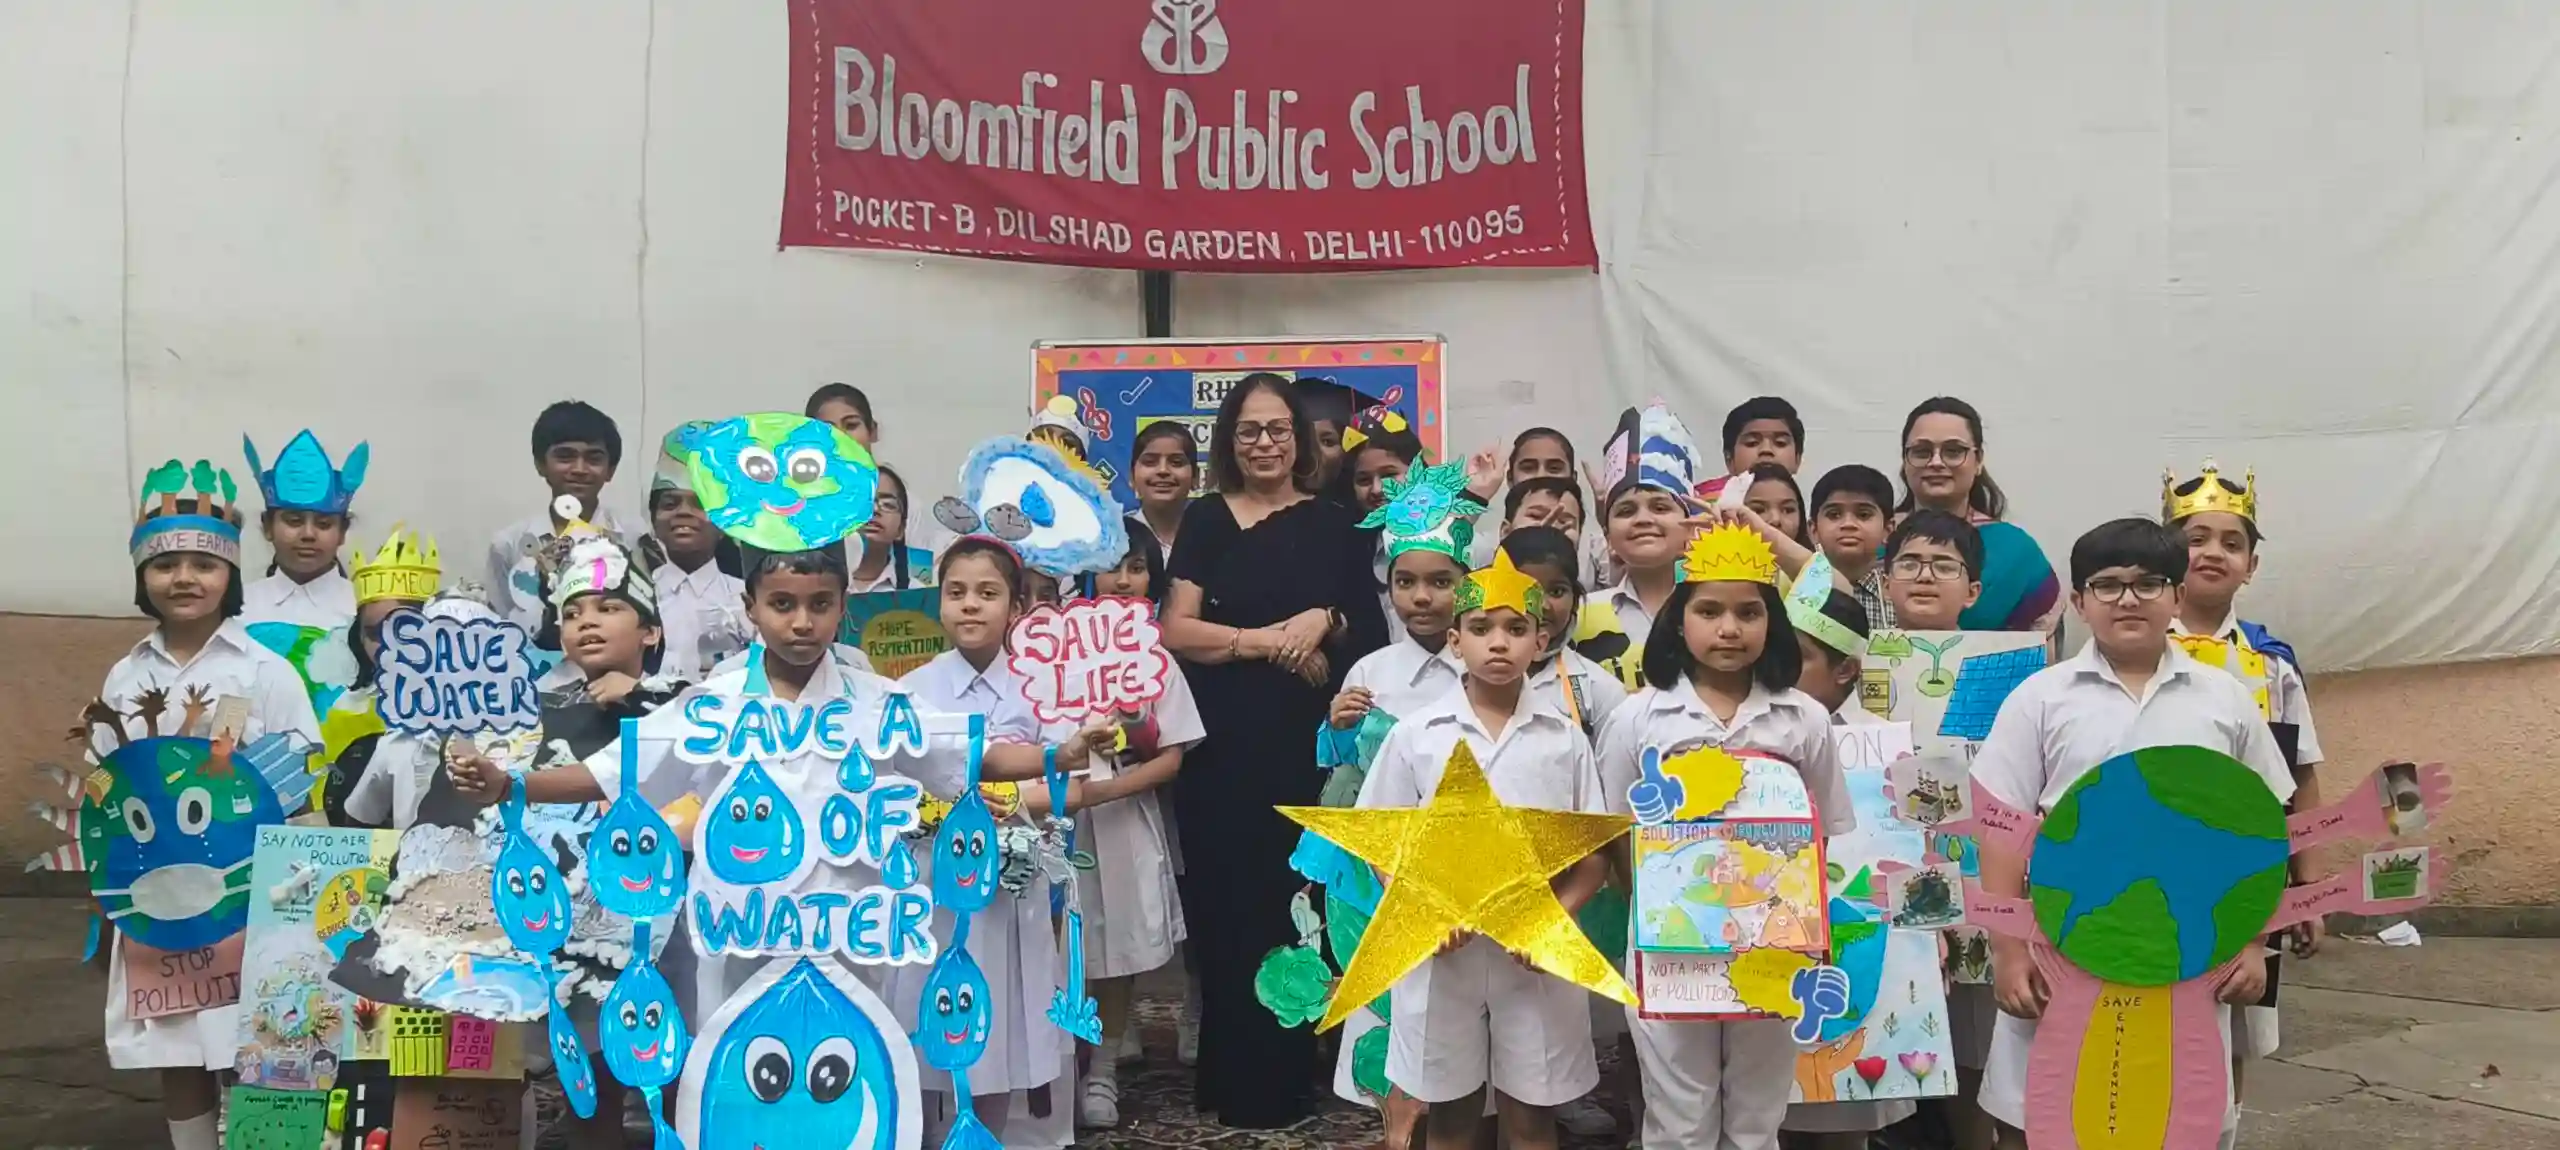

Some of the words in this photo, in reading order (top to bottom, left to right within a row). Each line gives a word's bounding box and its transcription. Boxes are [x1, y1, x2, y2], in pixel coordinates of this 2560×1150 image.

[833, 46, 1140, 186] Bloomfield
[1161, 87, 1330, 191] Public
[1348, 62, 1538, 191] School
[994, 206, 1132, 253] DILSHAD
[147, 531, 189, 557] SAVE
[393, 614, 509, 675] SAVE
[1024, 610, 1141, 664] SAVE
[395, 673, 539, 721] WATER
[1053, 661, 1145, 709] LIFE
[683, 694, 853, 758] SAVE
[877, 692, 923, 751] A
[260, 830, 288, 848] SAY
[819, 783, 919, 862] OF
[309, 849, 372, 866] POLLUTION
[693, 886, 932, 961] WATER
[159, 946, 215, 978] STOP
[132, 971, 241, 1017] POLLUTI
[2102, 996, 2142, 1008] SAVE
